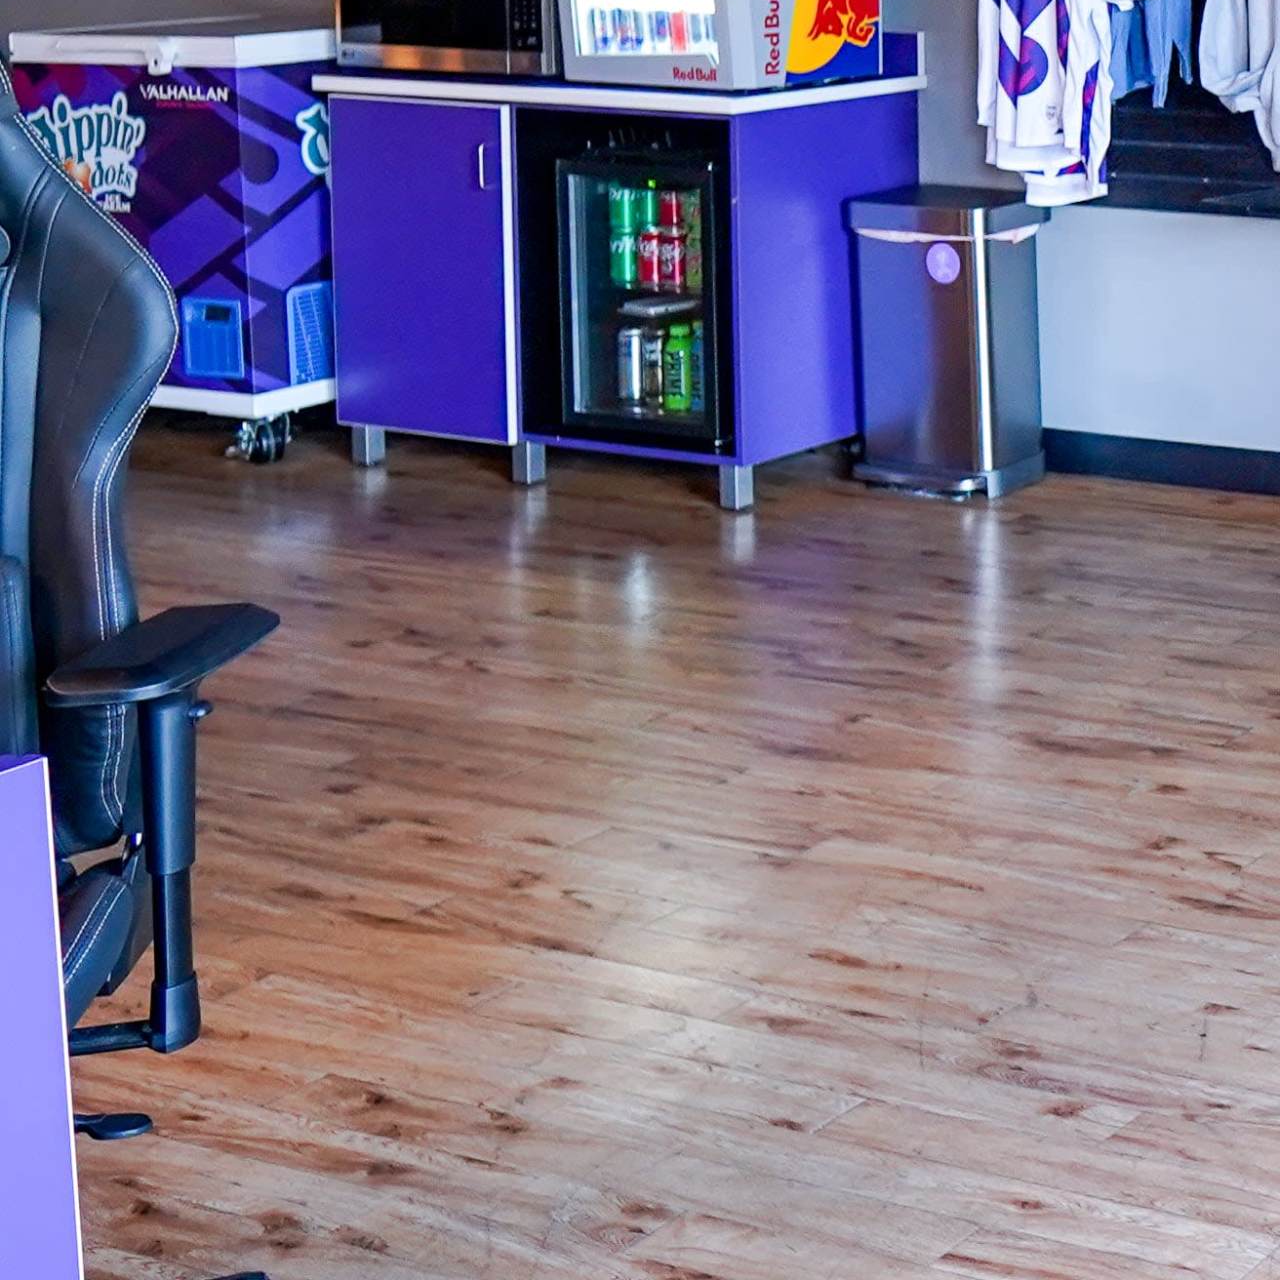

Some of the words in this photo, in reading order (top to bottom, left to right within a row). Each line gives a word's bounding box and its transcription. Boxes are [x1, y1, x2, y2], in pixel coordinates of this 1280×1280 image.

[763, 32, 780, 75] Red
[673, 67, 694, 81] Red
[695, 68, 718, 81] Bull
[140, 84, 230, 102] VALHALLAN
